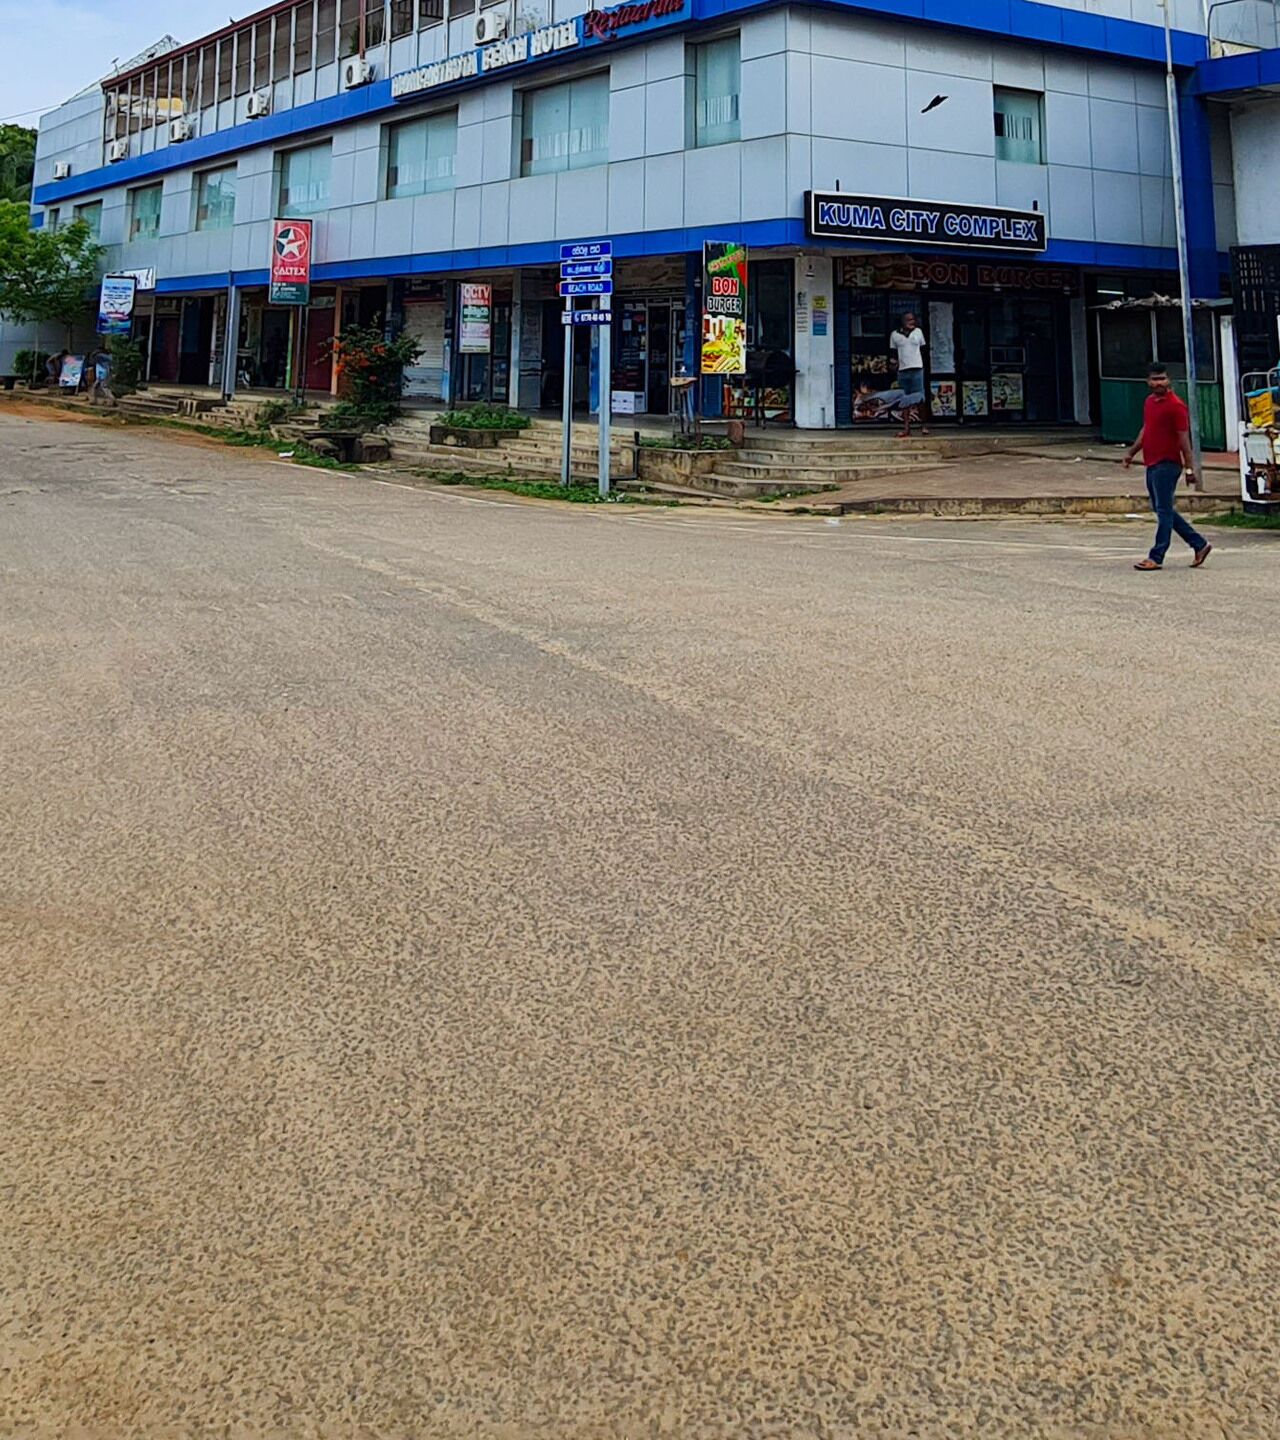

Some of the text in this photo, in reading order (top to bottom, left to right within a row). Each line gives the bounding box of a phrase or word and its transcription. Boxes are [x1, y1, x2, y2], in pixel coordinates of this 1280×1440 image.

[481, 35, 528, 71] BEACH
[530, 20, 579, 57] HOTEL
[819, 202, 1038, 242] KUMA CITY COMPLEX
[273, 266, 306, 276] CALTEX
[910, 261, 1077, 291] BON BURGER
[463, 286, 490, 299] CCTV
[568, 283, 604, 293] BEACH ROAD
[712, 276, 740, 296] BON
[707, 296, 742, 314] BURGER
